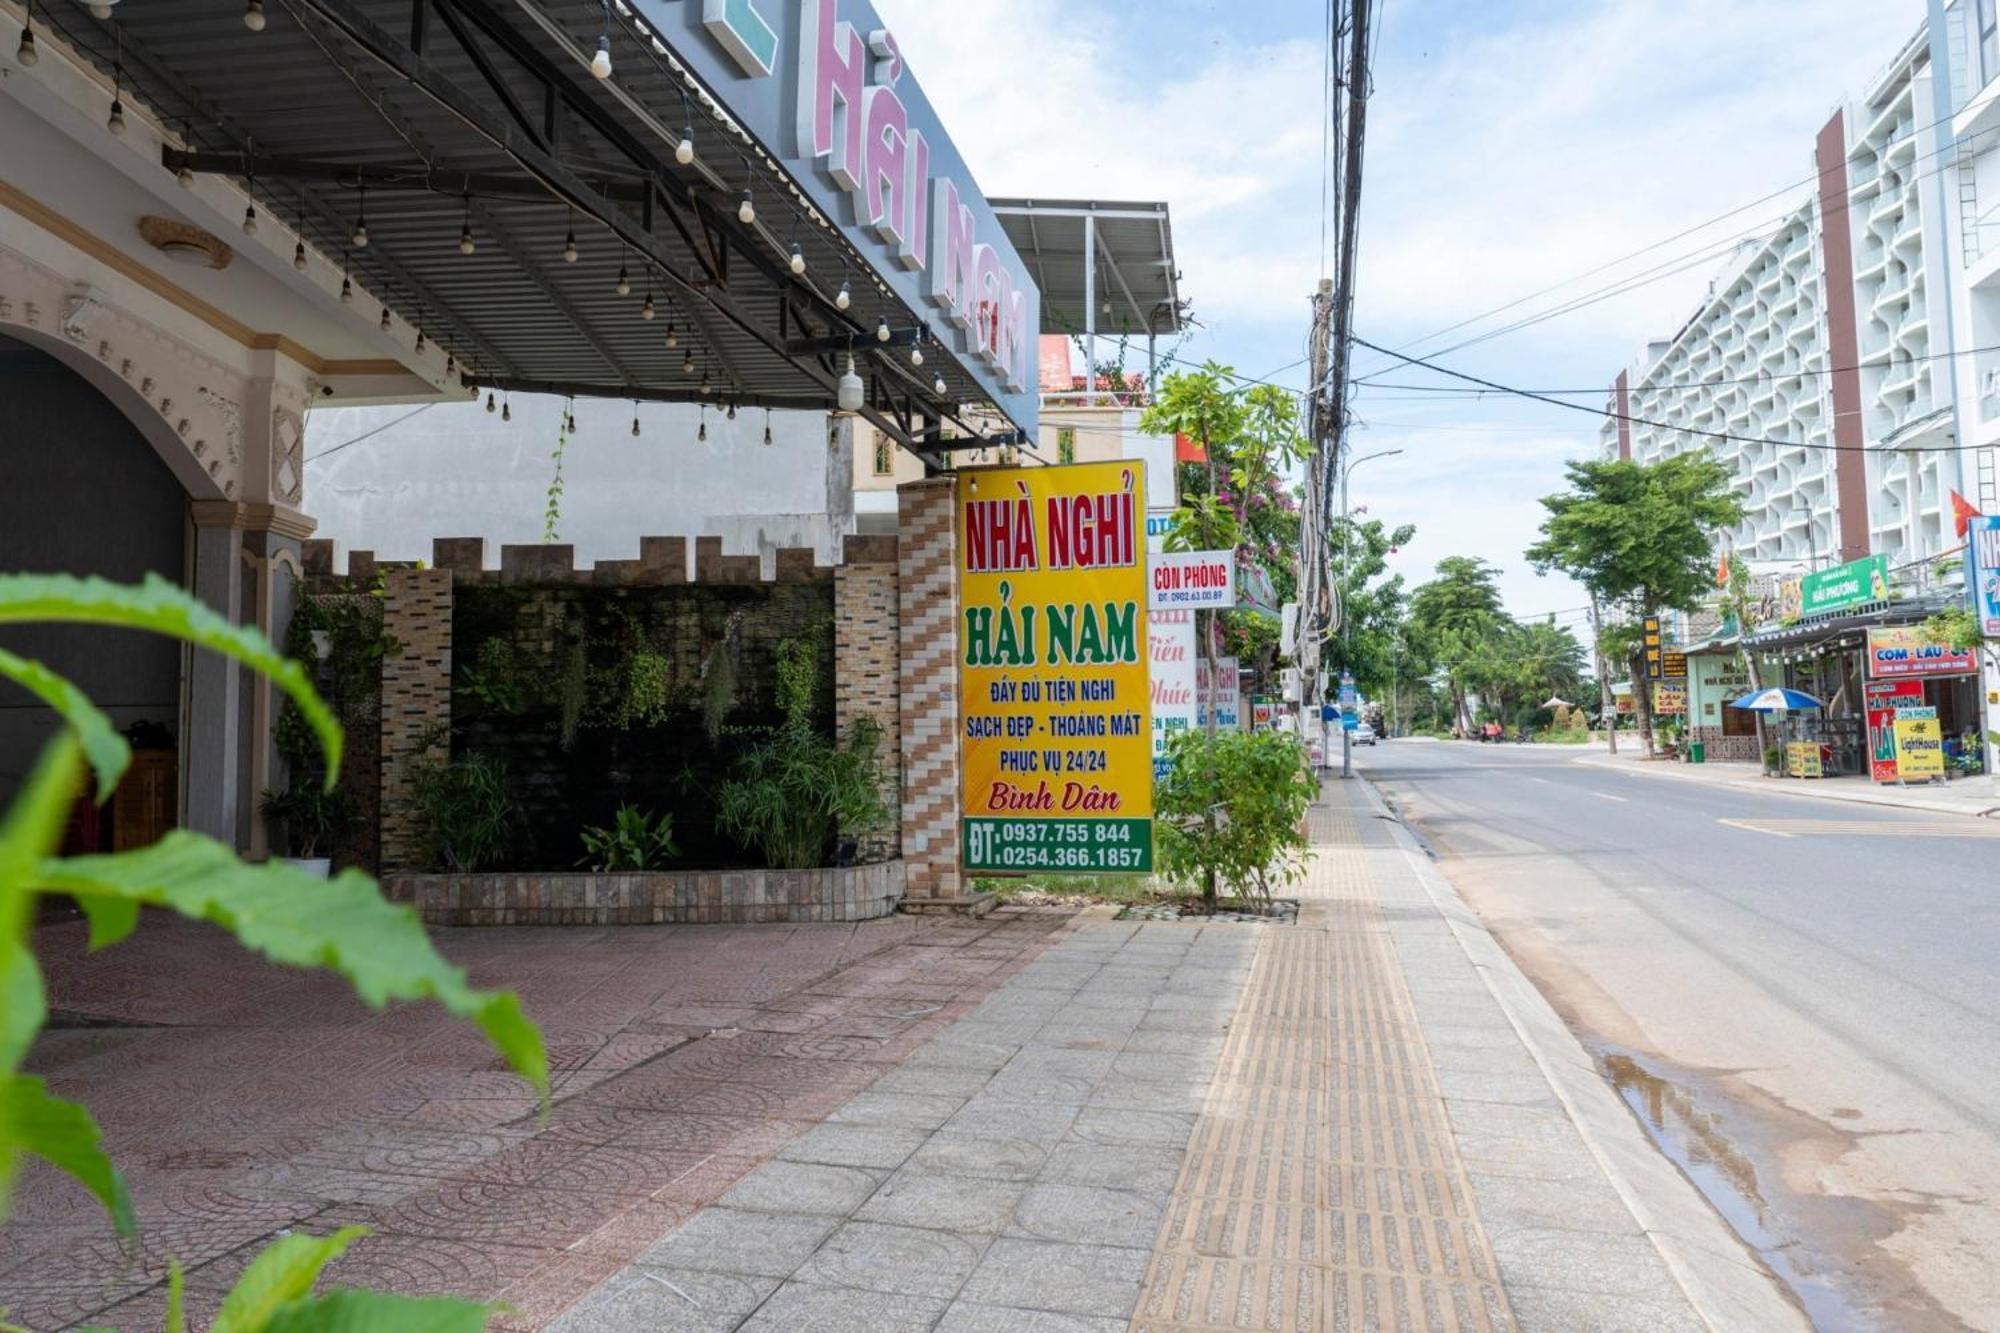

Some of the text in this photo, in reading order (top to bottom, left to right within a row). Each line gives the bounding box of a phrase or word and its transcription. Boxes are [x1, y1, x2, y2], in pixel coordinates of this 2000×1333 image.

[965, 469, 1136, 572] NHÀ NGHỈ
[1183, 559, 1227, 588] PHÒNG
[964, 580, 1138, 666] HẢI NAM
[1045, 675, 1076, 707] TIỆN
[1080, 679, 1115, 701] NGHI
[966, 715, 1003, 742] SẠCH
[1006, 717, 1034, 742] ĐẸP
[1000, 750, 1106, 776] PHỤC VỤ 24/24
[988, 781, 1120, 811] Bình Dân
[1002, 824, 1130, 842] 0937.755 844
[1002, 847, 1142, 867] 0254.366.1857
